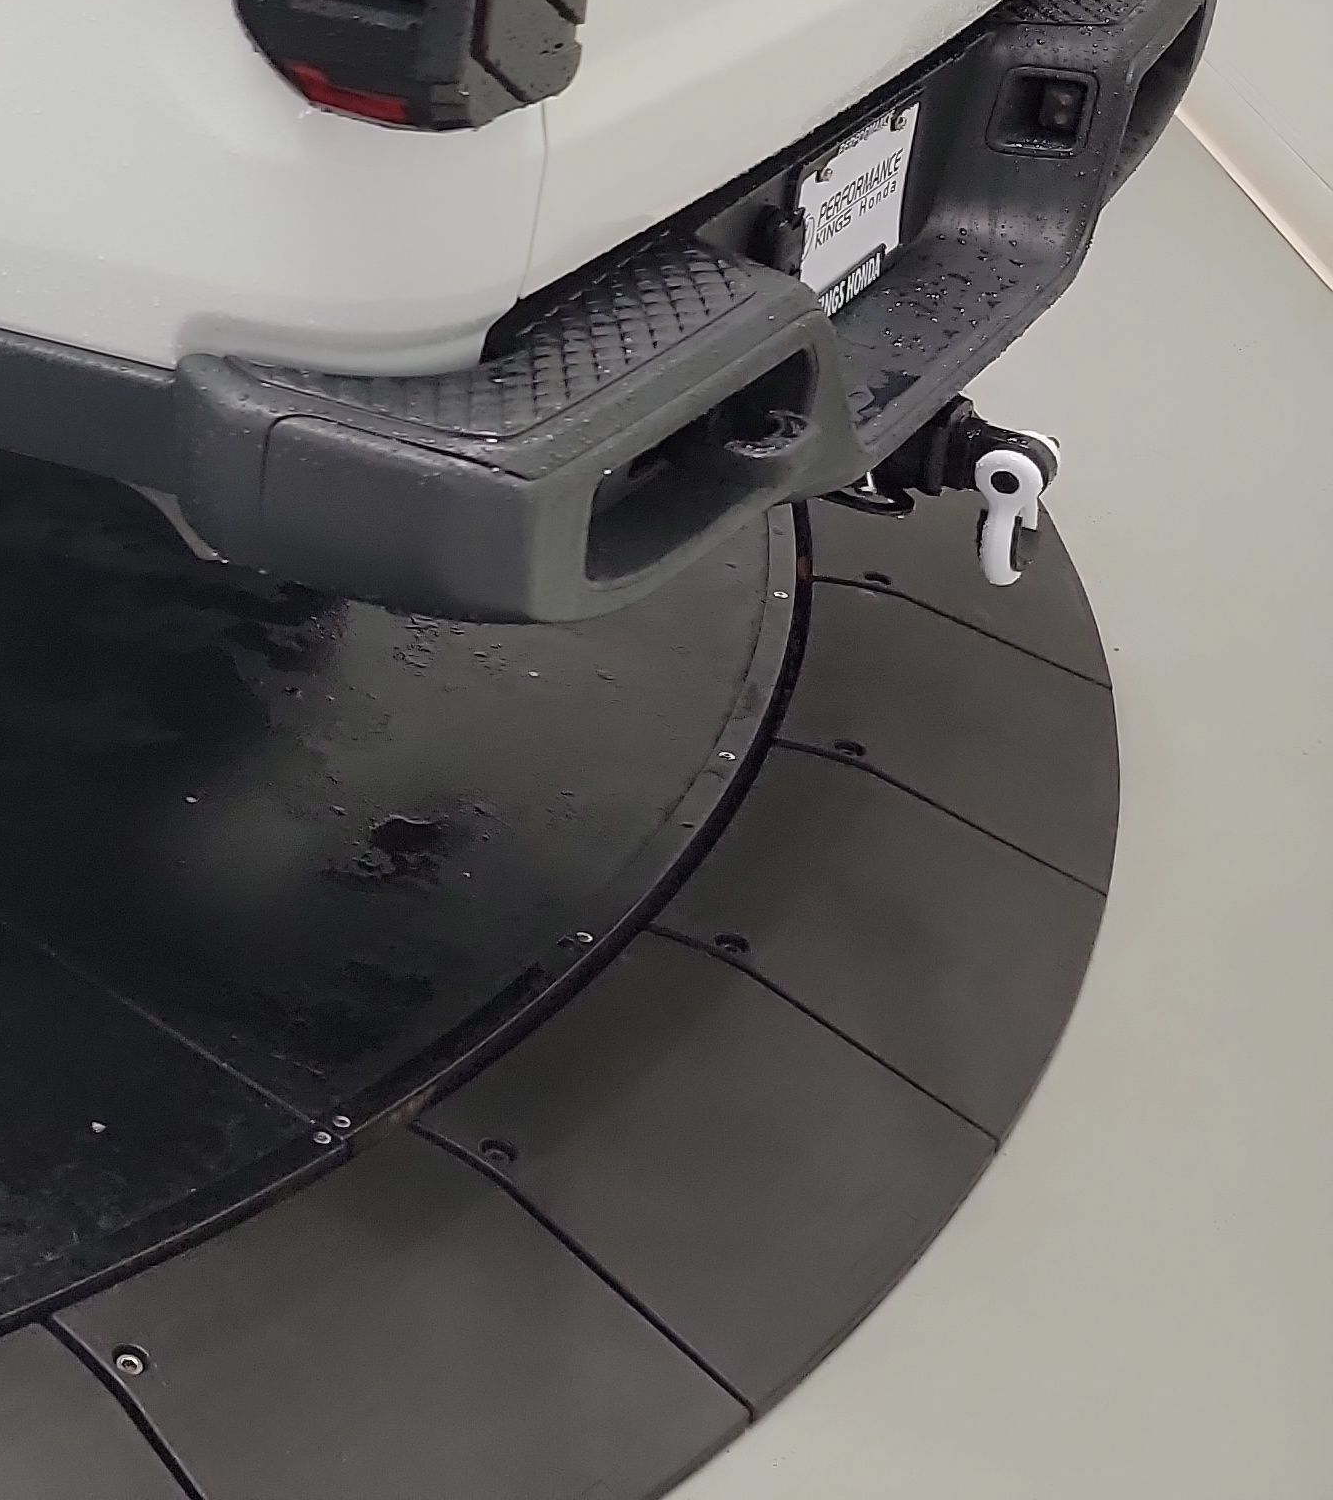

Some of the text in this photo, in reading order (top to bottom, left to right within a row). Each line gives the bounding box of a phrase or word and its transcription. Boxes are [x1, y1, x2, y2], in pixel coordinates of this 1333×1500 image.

[815, 180, 897, 250] KINGS Honda
[818, 148, 903, 227] PERFORMANCE
[846, 252, 881, 303] HONDA
